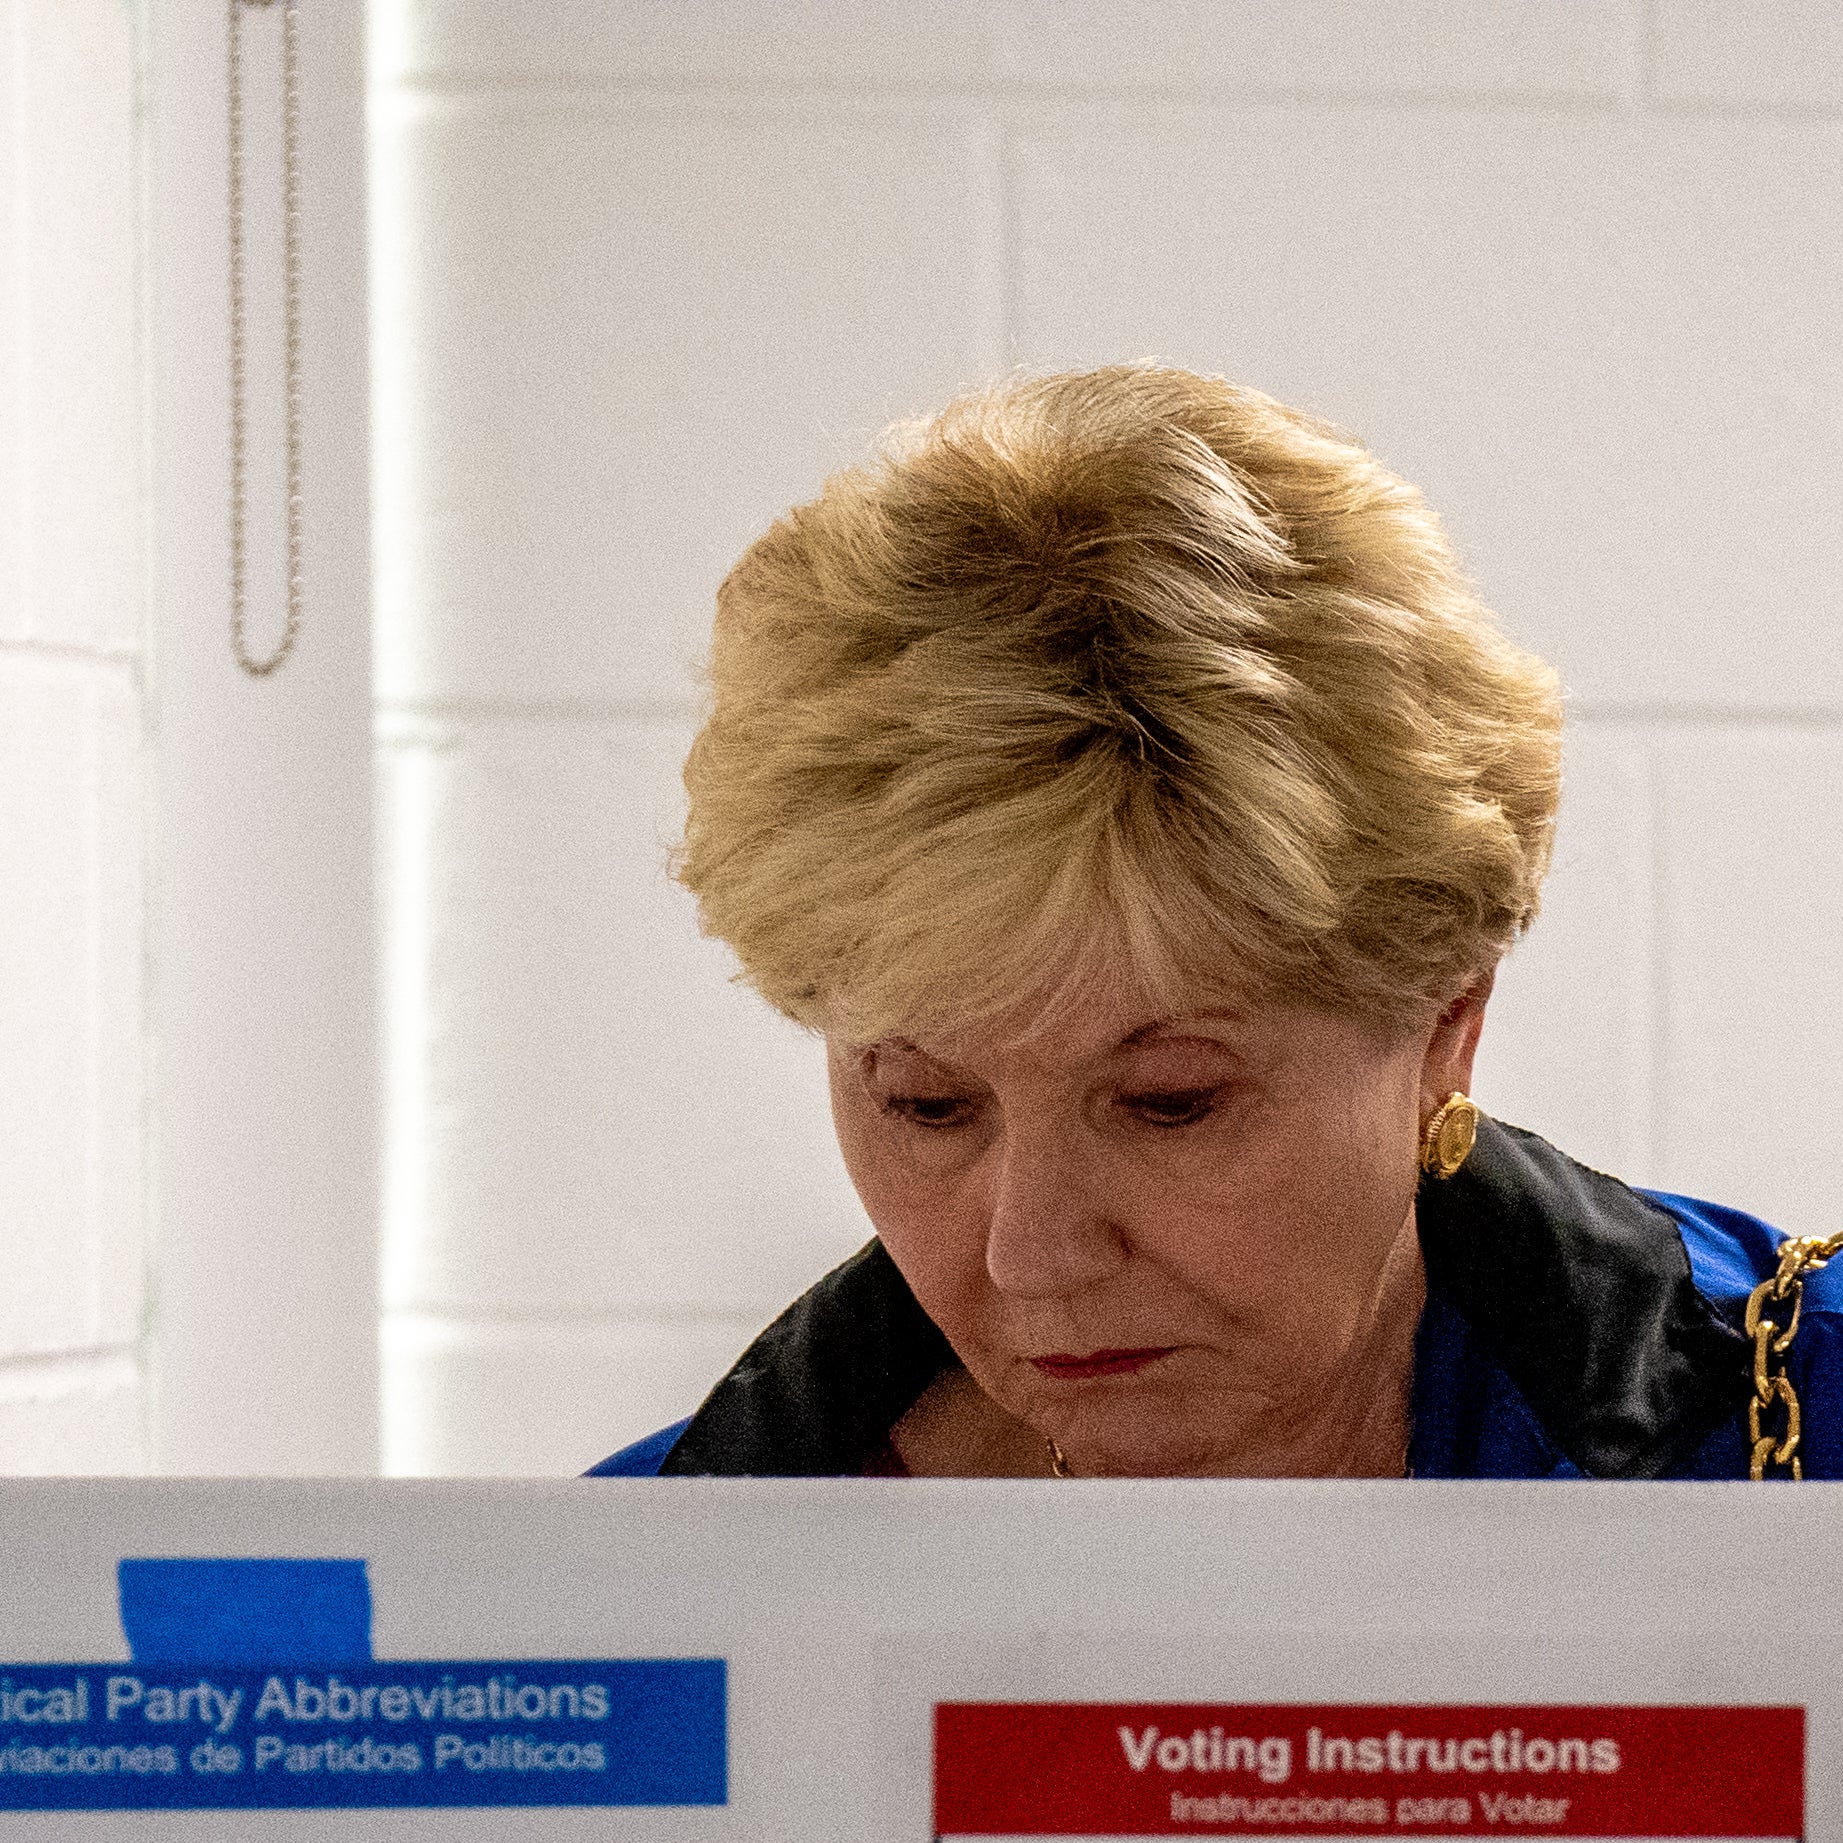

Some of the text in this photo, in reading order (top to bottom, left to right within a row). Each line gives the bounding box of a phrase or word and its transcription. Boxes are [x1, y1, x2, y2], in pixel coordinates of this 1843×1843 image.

[106, 1675, 243, 1733] Party
[254, 1676, 610, 1722] Abbreviations
[189, 1738, 243, 1774] de
[254, 1735, 423, 1773] Partidos
[1118, 1726, 1621, 1783] Voting Instructions
[1170, 1791, 1570, 1830] Instrucciones para Votar
